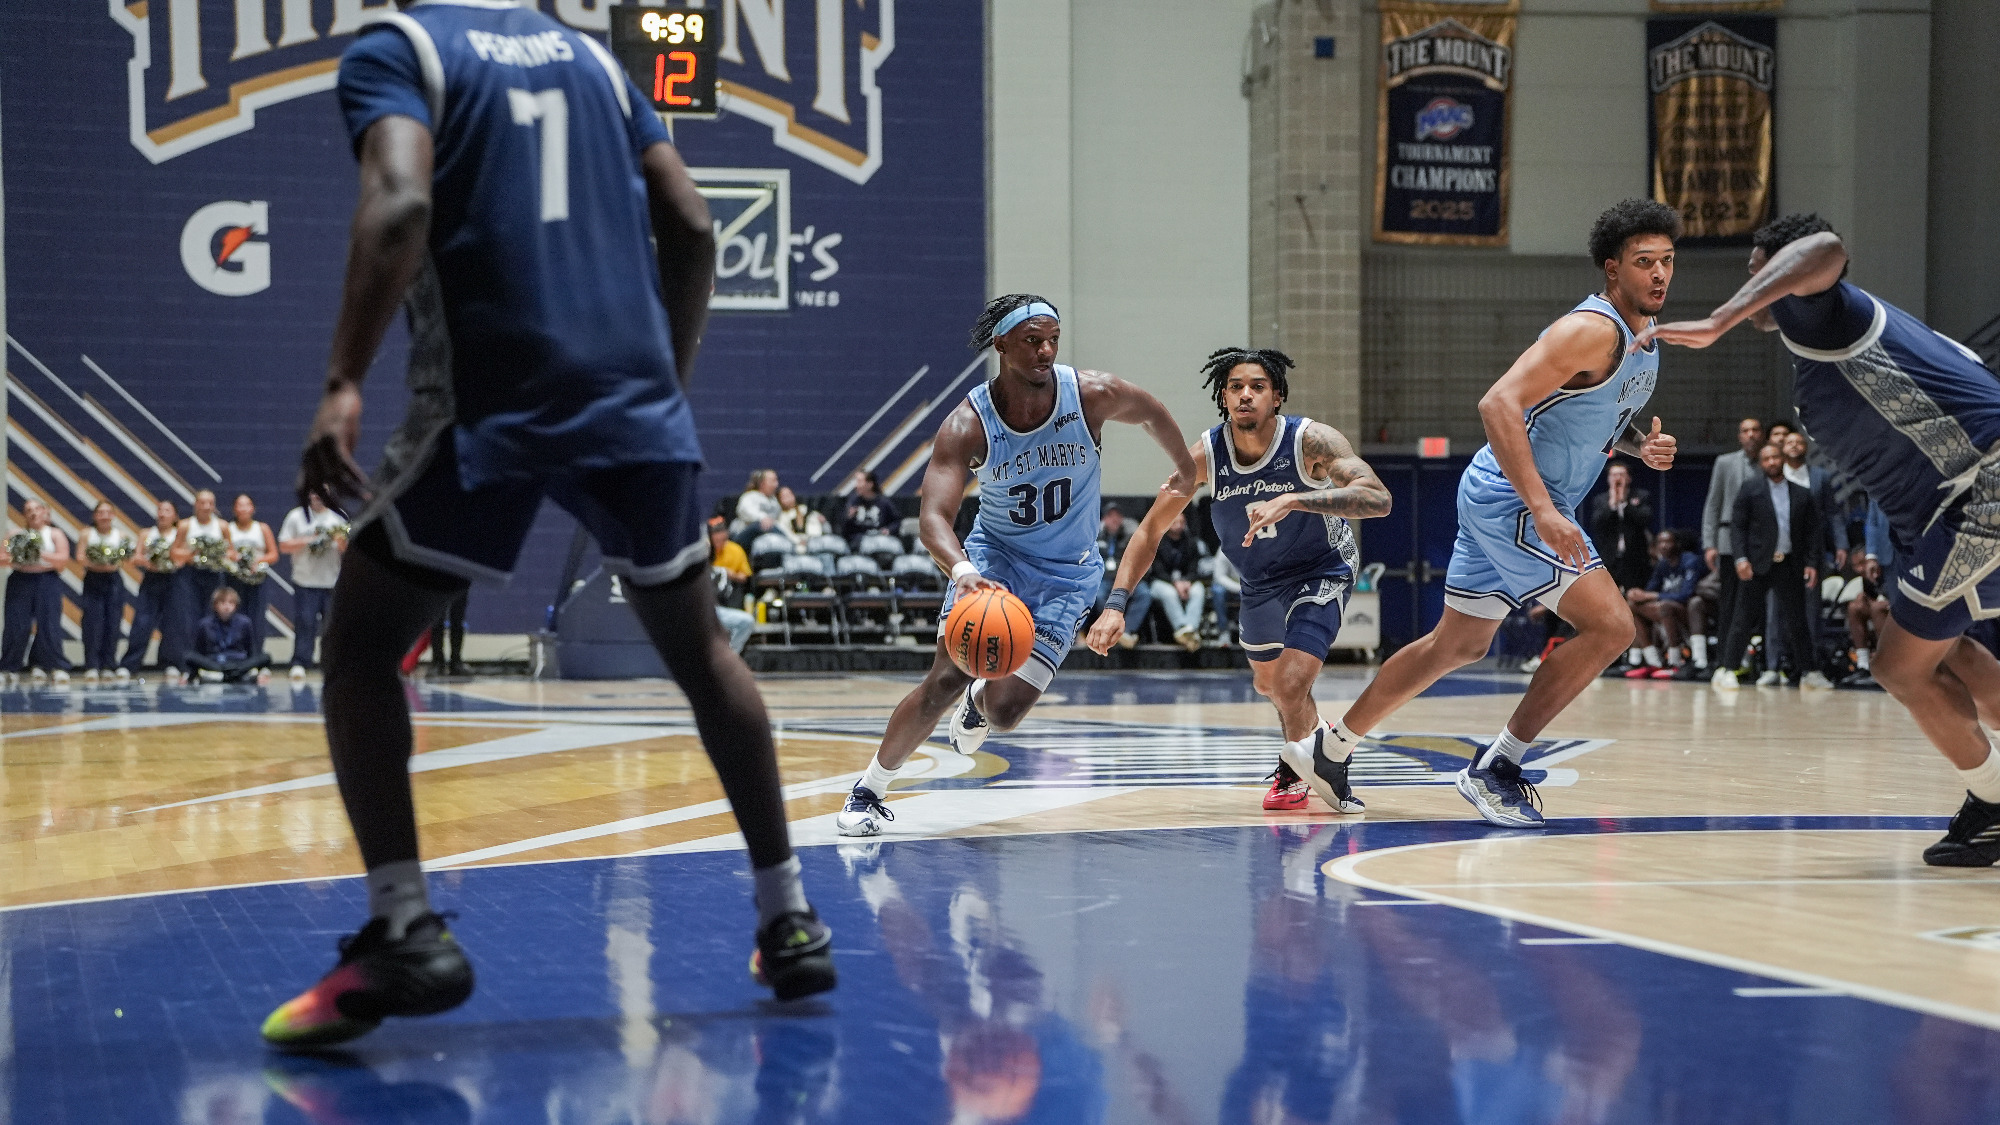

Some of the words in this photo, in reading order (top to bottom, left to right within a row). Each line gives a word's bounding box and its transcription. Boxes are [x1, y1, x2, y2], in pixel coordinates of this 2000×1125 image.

[641, 12, 704, 44] 9:59
[466, 29, 575, 68] PERKINS
[1391, 39, 1431, 78] THE
[1433, 36, 1505, 79] MOUNT
[1655, 45, 1696, 83] THE
[1700, 43, 1768, 81] MOUNT
[654, 51, 697, 105] 12
[507, 87, 569, 223] 7
[1398, 142, 1493, 165] TOURNAMENT
[1391, 164, 1497, 193] CHAMPIONS
[180, 200, 271, 297] G
[1053, 411, 1080, 433] MAAC
[992, 461, 1013, 481] MT.
[1015, 449, 1035, 475] ST.
[1036, 442, 1087, 468] MARY'S
[1008, 476, 1073, 527] 30
[1215, 483, 1253, 502] Saint
[1252, 479, 1295, 496] Peter's
[985, 635, 1000, 673] NCAA
